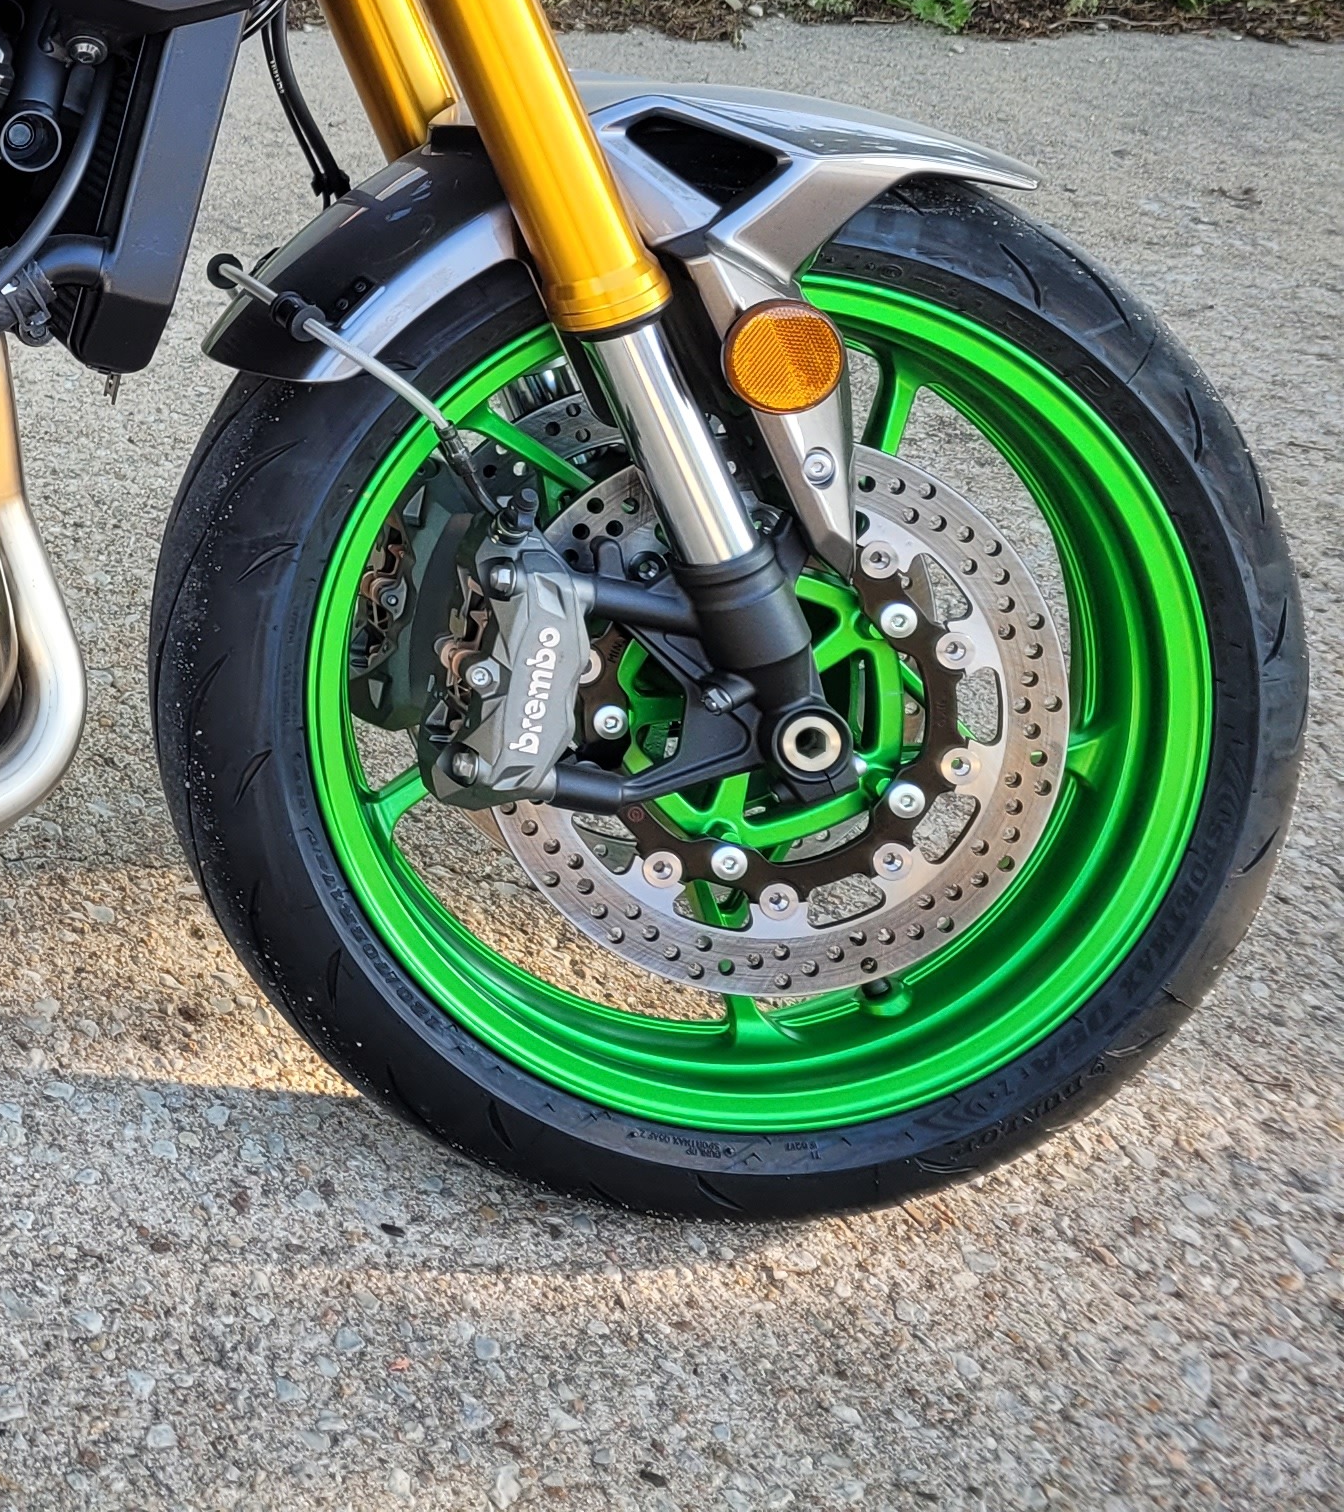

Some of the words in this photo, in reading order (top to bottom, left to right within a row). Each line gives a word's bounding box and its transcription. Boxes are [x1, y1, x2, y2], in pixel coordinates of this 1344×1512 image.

[509, 626, 561, 755] brembo
[1114, 819, 1227, 999] SPORTMAX
[947, 1074, 1088, 1159] DUNLOP
